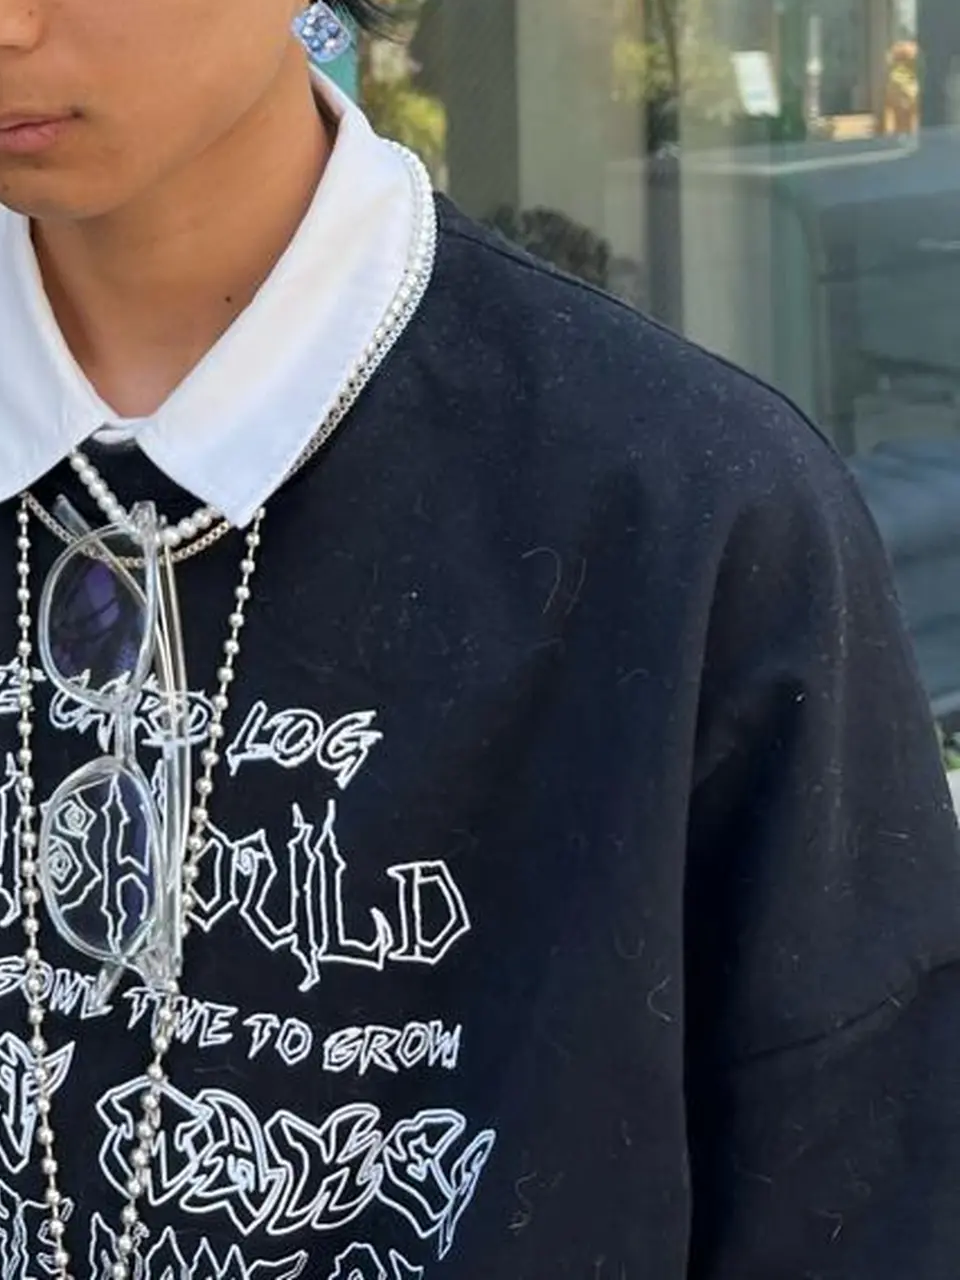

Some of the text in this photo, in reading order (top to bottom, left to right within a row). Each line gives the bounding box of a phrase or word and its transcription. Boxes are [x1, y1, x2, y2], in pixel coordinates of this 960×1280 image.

[226, 701, 383, 790] LOG
[243, 1012, 313, 1067] TO
[322, 1022, 463, 1076] GROW
